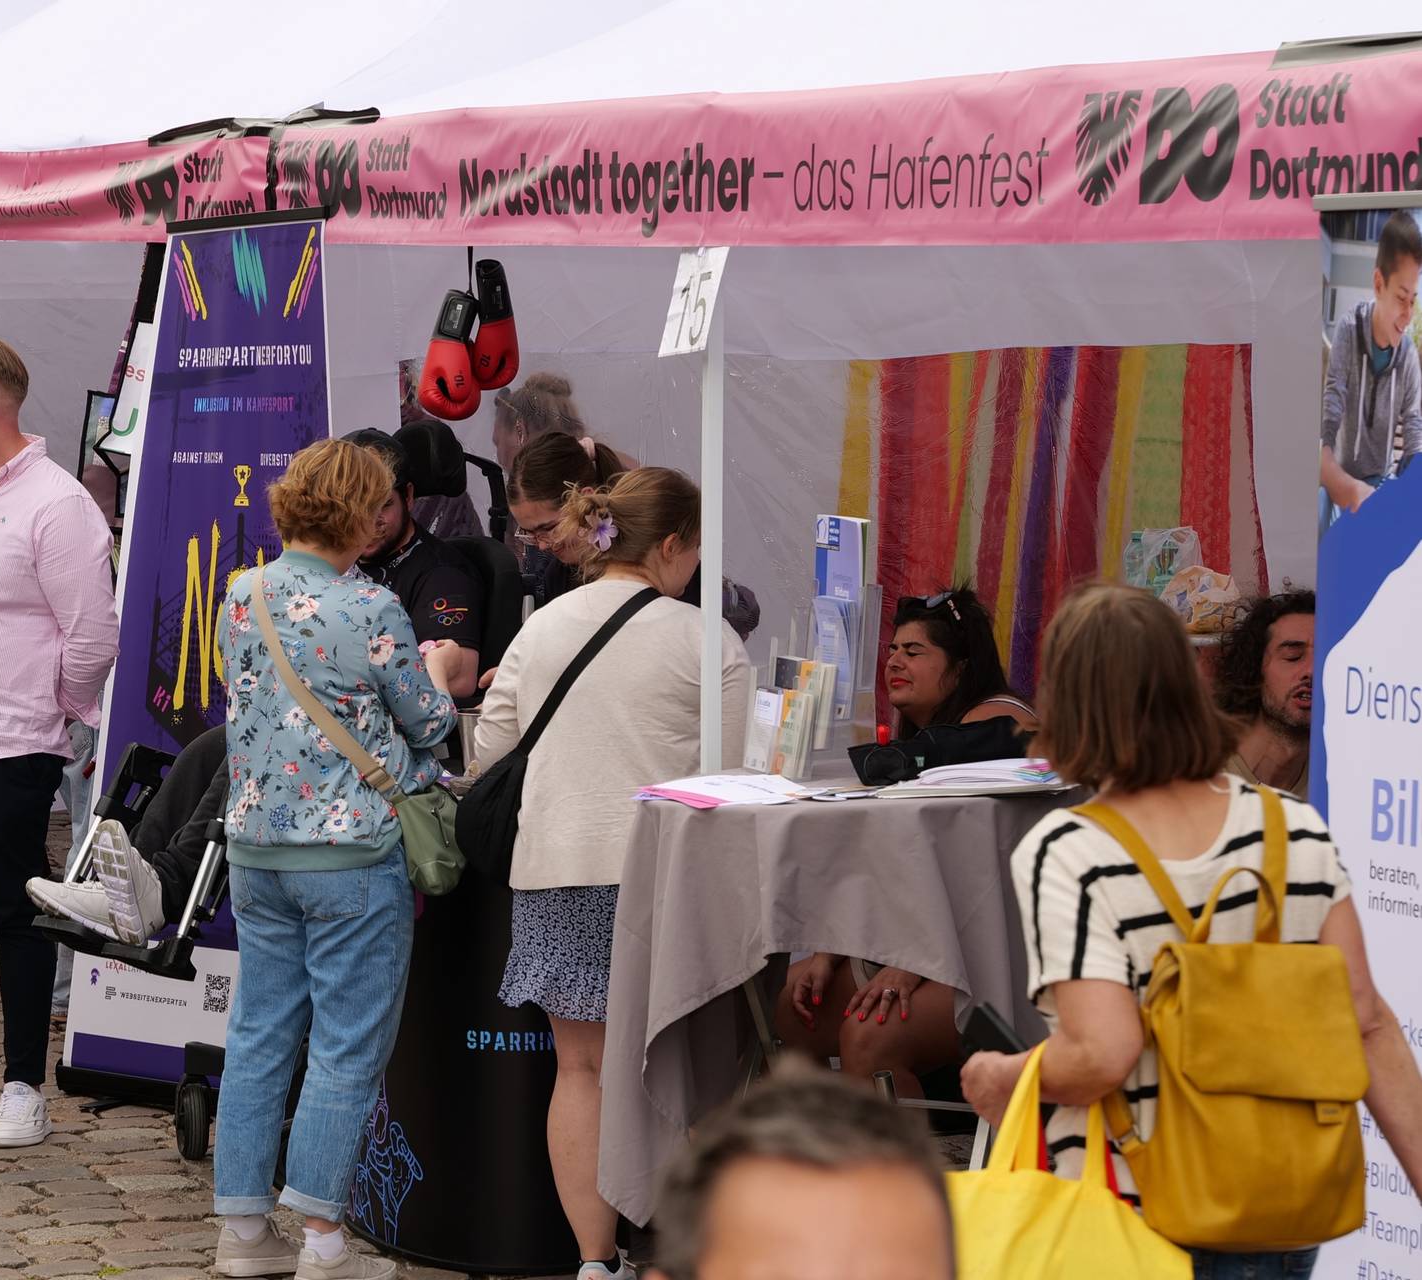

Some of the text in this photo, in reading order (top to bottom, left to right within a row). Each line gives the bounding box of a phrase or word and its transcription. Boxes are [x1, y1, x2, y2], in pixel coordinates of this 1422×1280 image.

[1255, 72, 1353, 128] Stadt
[182, 151, 224, 183] Stadt
[365, 136, 410, 172] Stadt
[1249, 137, 1422, 200] Dortmund
[366, 183, 448, 219] Dortmund
[459, 149, 603, 217] Nordstadt
[609, 142, 755, 239] together
[794, 143, 855, 211] das
[869, 132, 1049, 211] Hafenfest
[184, 192, 256, 219] Dortmund
[675, 271, 712, 349] 15
[178, 344, 312, 368] SPARRINGPARTNERFORYOU
[193, 397, 229, 413] INKLUSION
[232, 397, 243, 412] IM
[172, 451, 203, 464] AGAINST
[260, 453, 293, 467] DIVERSITY
[1369, 859, 1419, 890] beraten,
